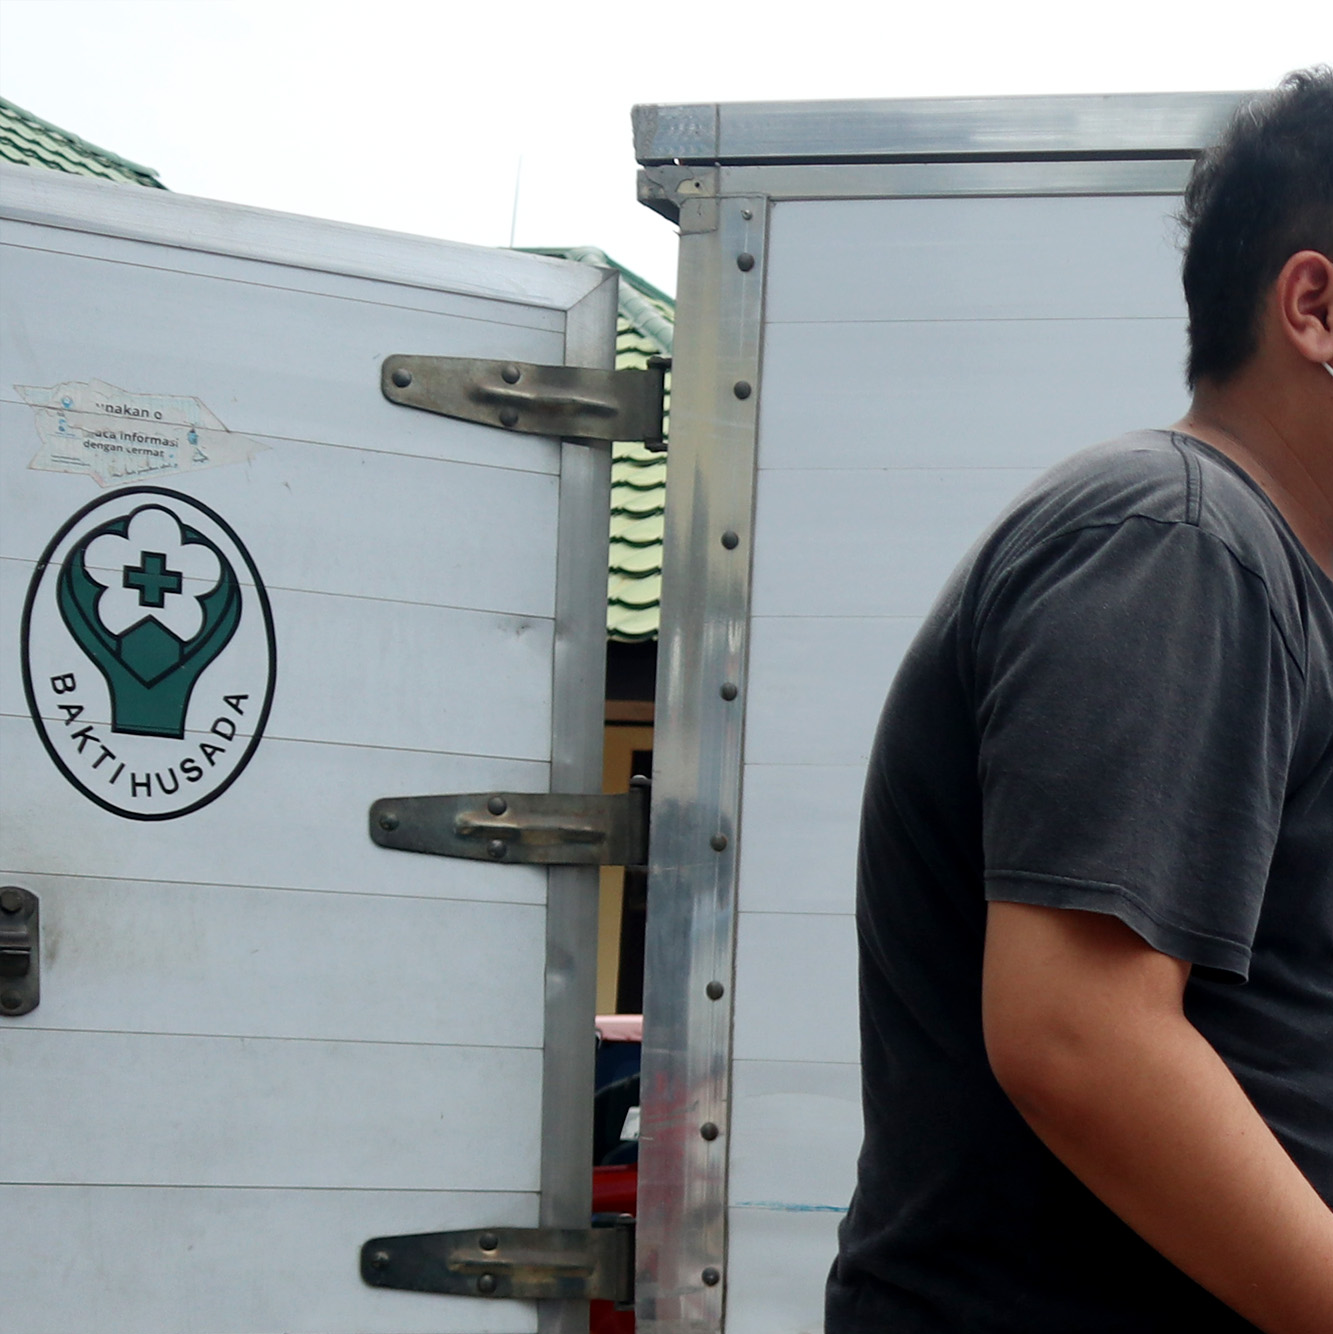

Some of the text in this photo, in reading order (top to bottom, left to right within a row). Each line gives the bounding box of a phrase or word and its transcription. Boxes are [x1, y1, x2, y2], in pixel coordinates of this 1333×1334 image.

[83, 439, 123, 453] dengan
[50, 673, 249, 797] BAKTI HUSADA
